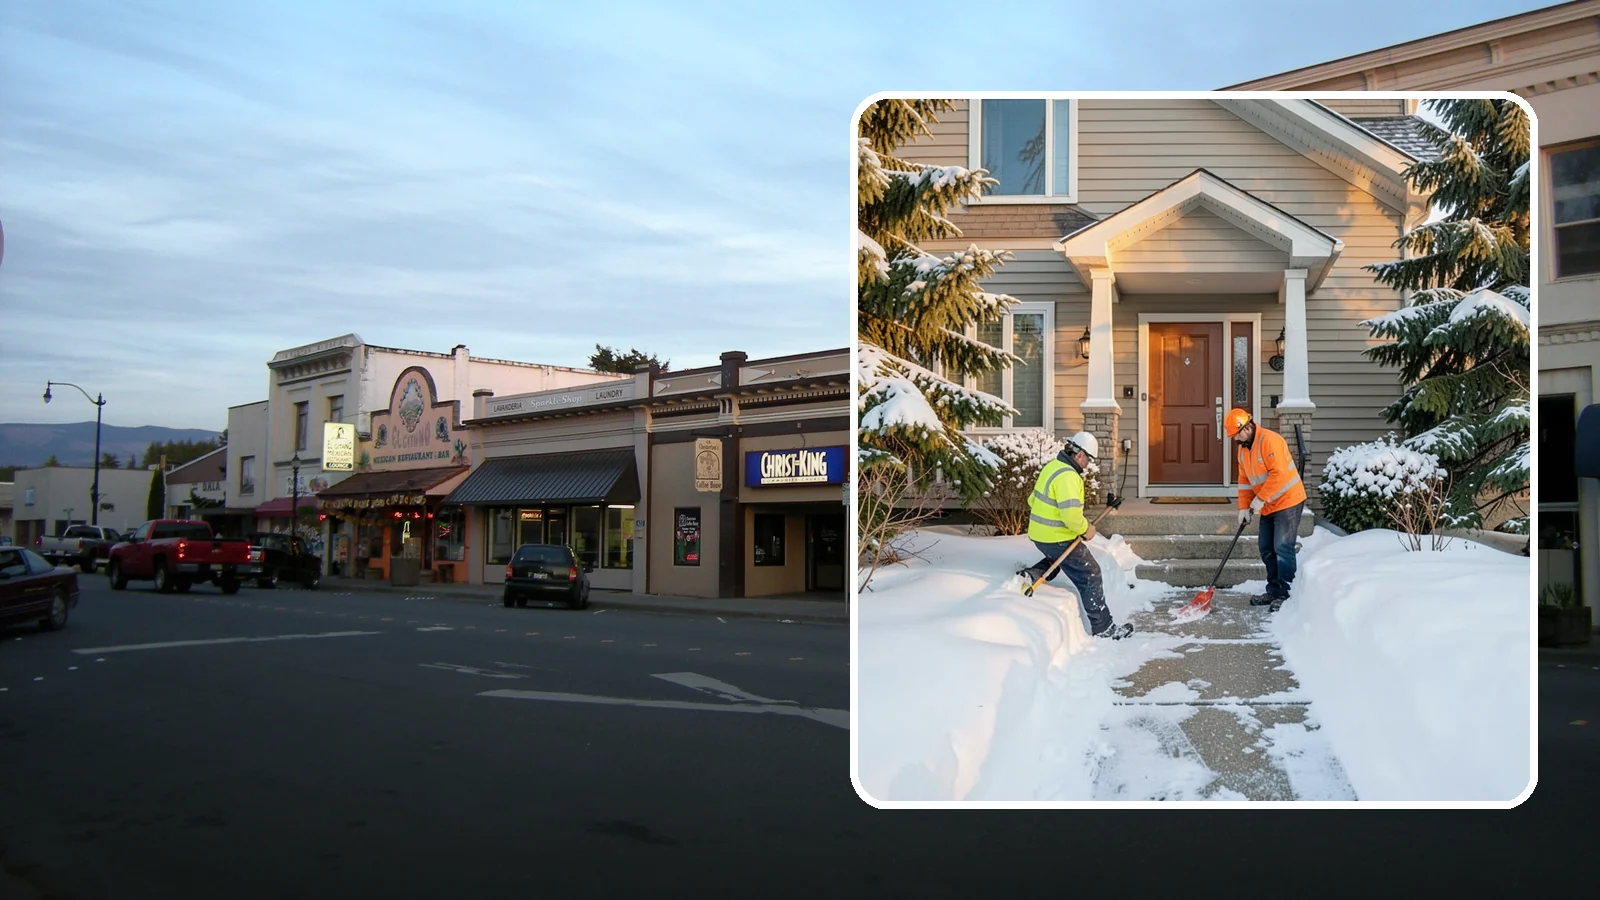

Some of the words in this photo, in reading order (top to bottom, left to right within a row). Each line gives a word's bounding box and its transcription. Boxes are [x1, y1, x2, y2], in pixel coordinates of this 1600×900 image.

[493, 402, 522, 413] LAVANDERIA
[531, 398, 560, 409] Sparkle
[562, 394, 582, 405] Shop
[595, 389, 623, 400] LAUNDRY
[374, 454, 396, 464] MEXICAN
[397, 451, 433, 462] RESTAURANT
[438, 450, 449, 459] BAR
[761, 452, 797, 477] CHRIST
[799, 450, 827, 476] KING
